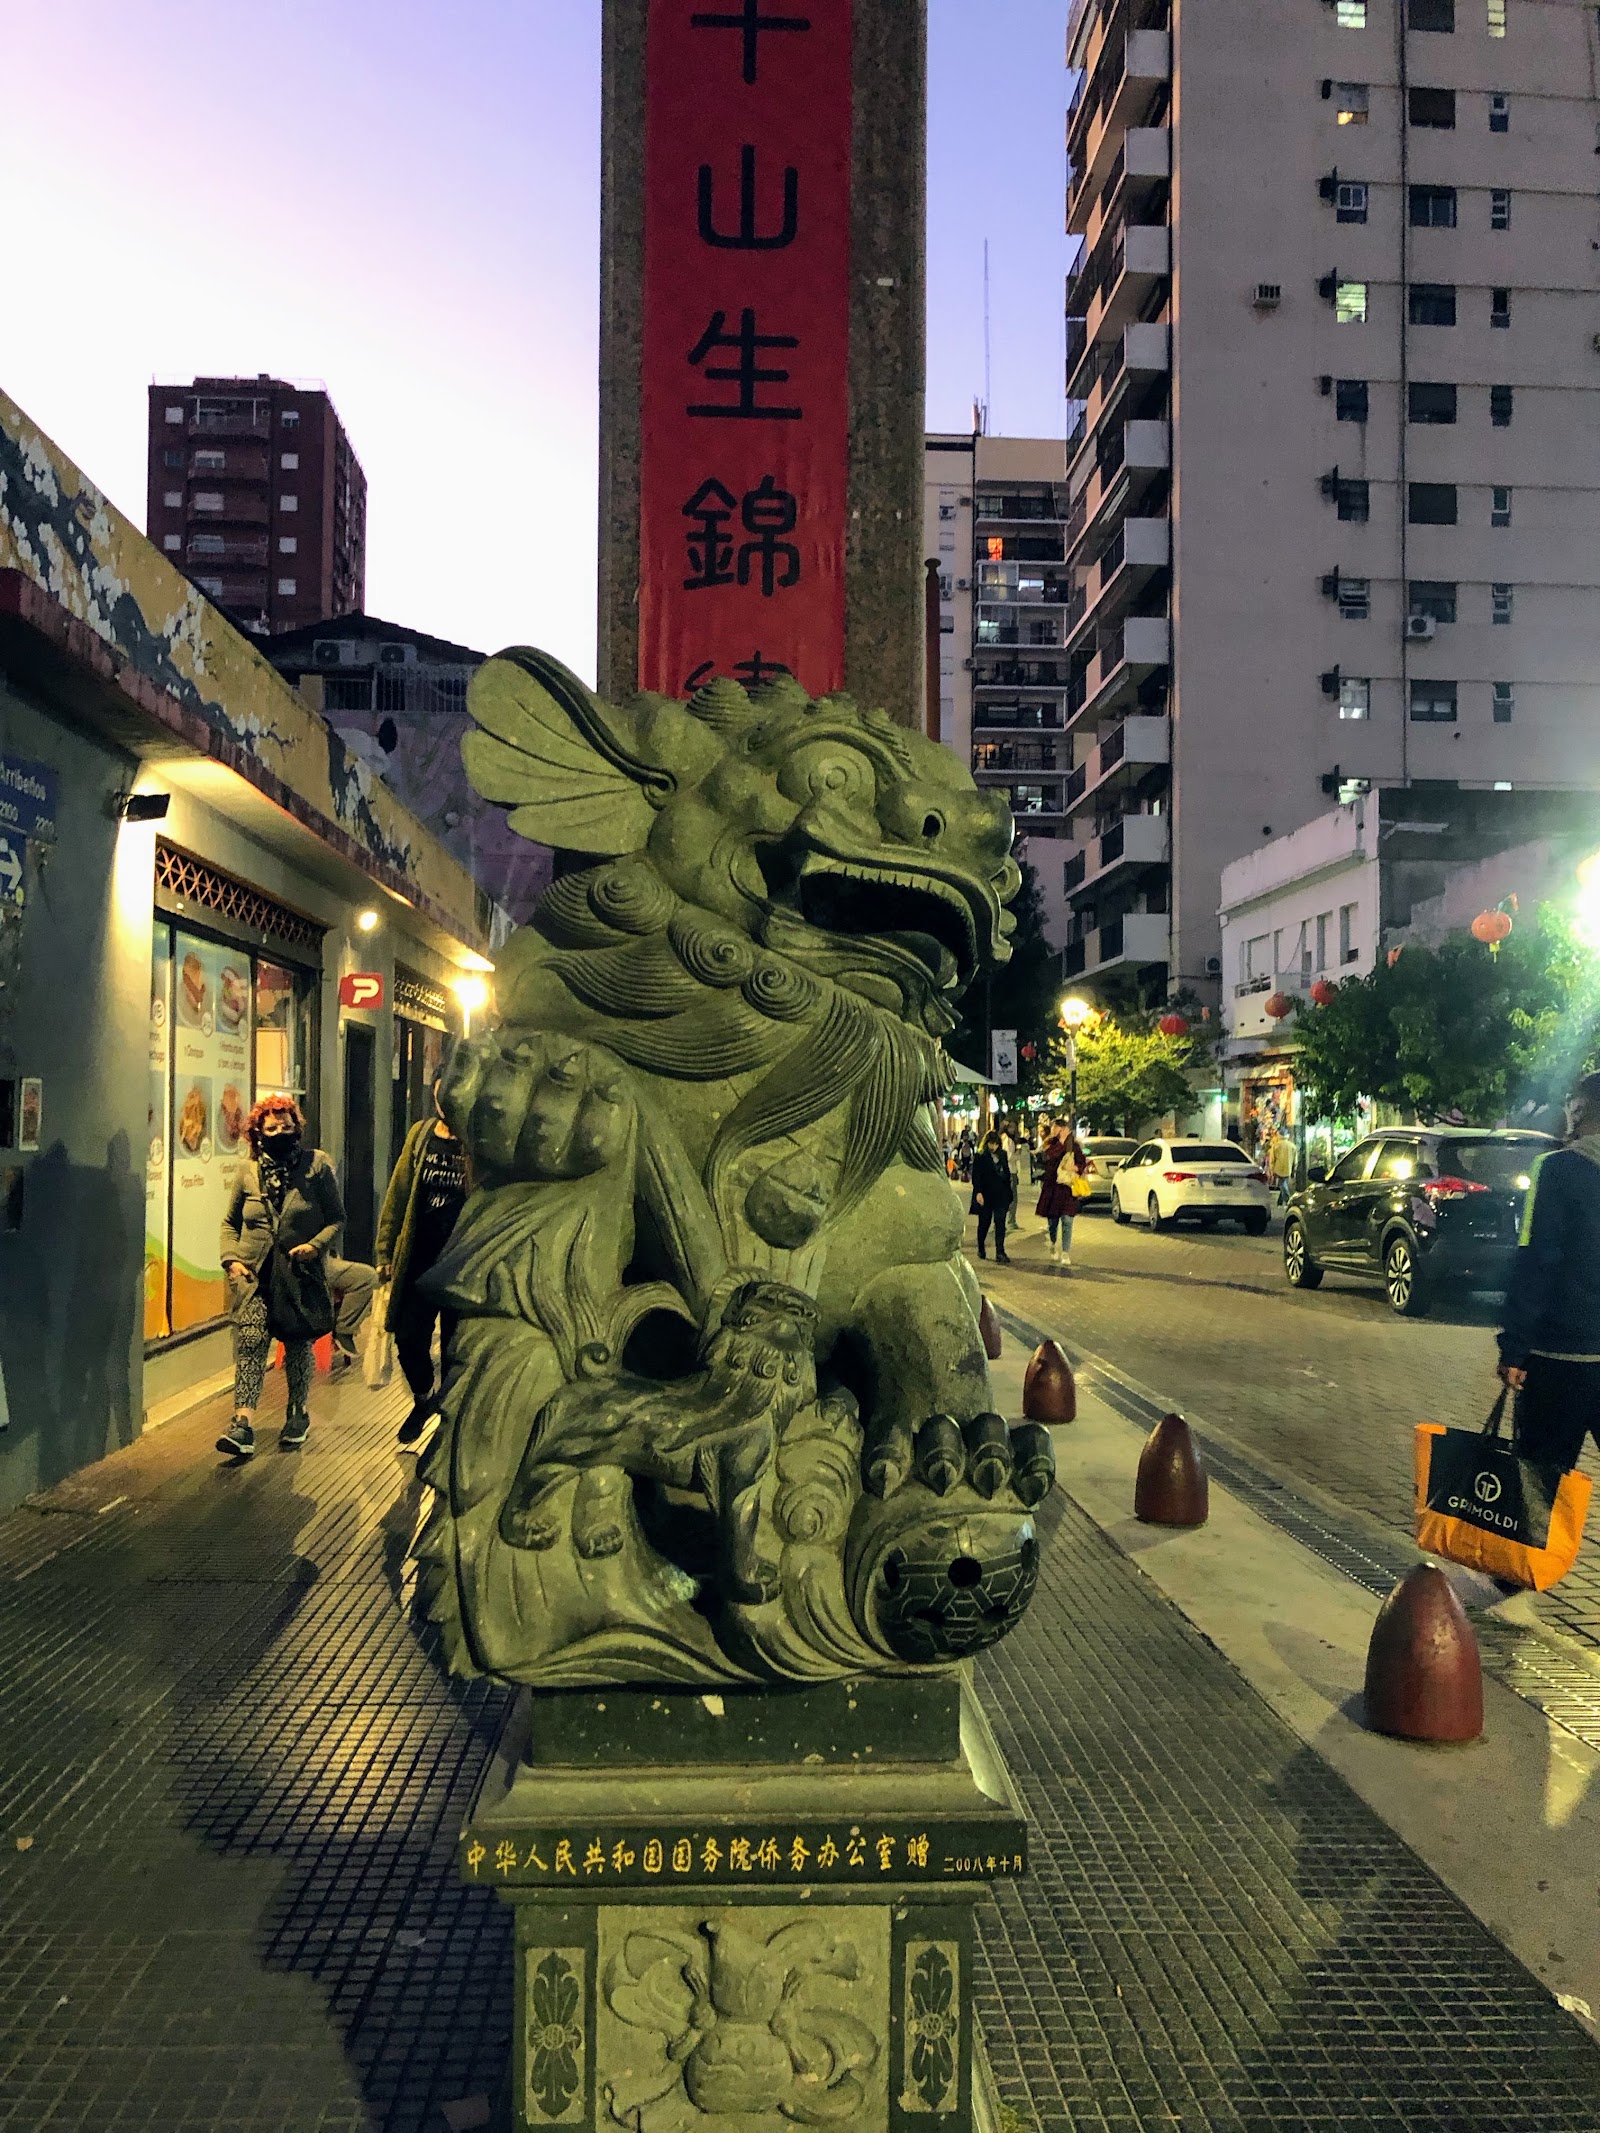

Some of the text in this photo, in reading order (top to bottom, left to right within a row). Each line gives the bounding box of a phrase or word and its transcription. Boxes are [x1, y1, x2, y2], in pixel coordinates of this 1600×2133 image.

[352, 978, 380, 1004] P
[1447, 1495, 1519, 1532] GRIMOLDI
[466, 1833, 932, 1877] 中华人民共和国国务院侨务办公室赠
